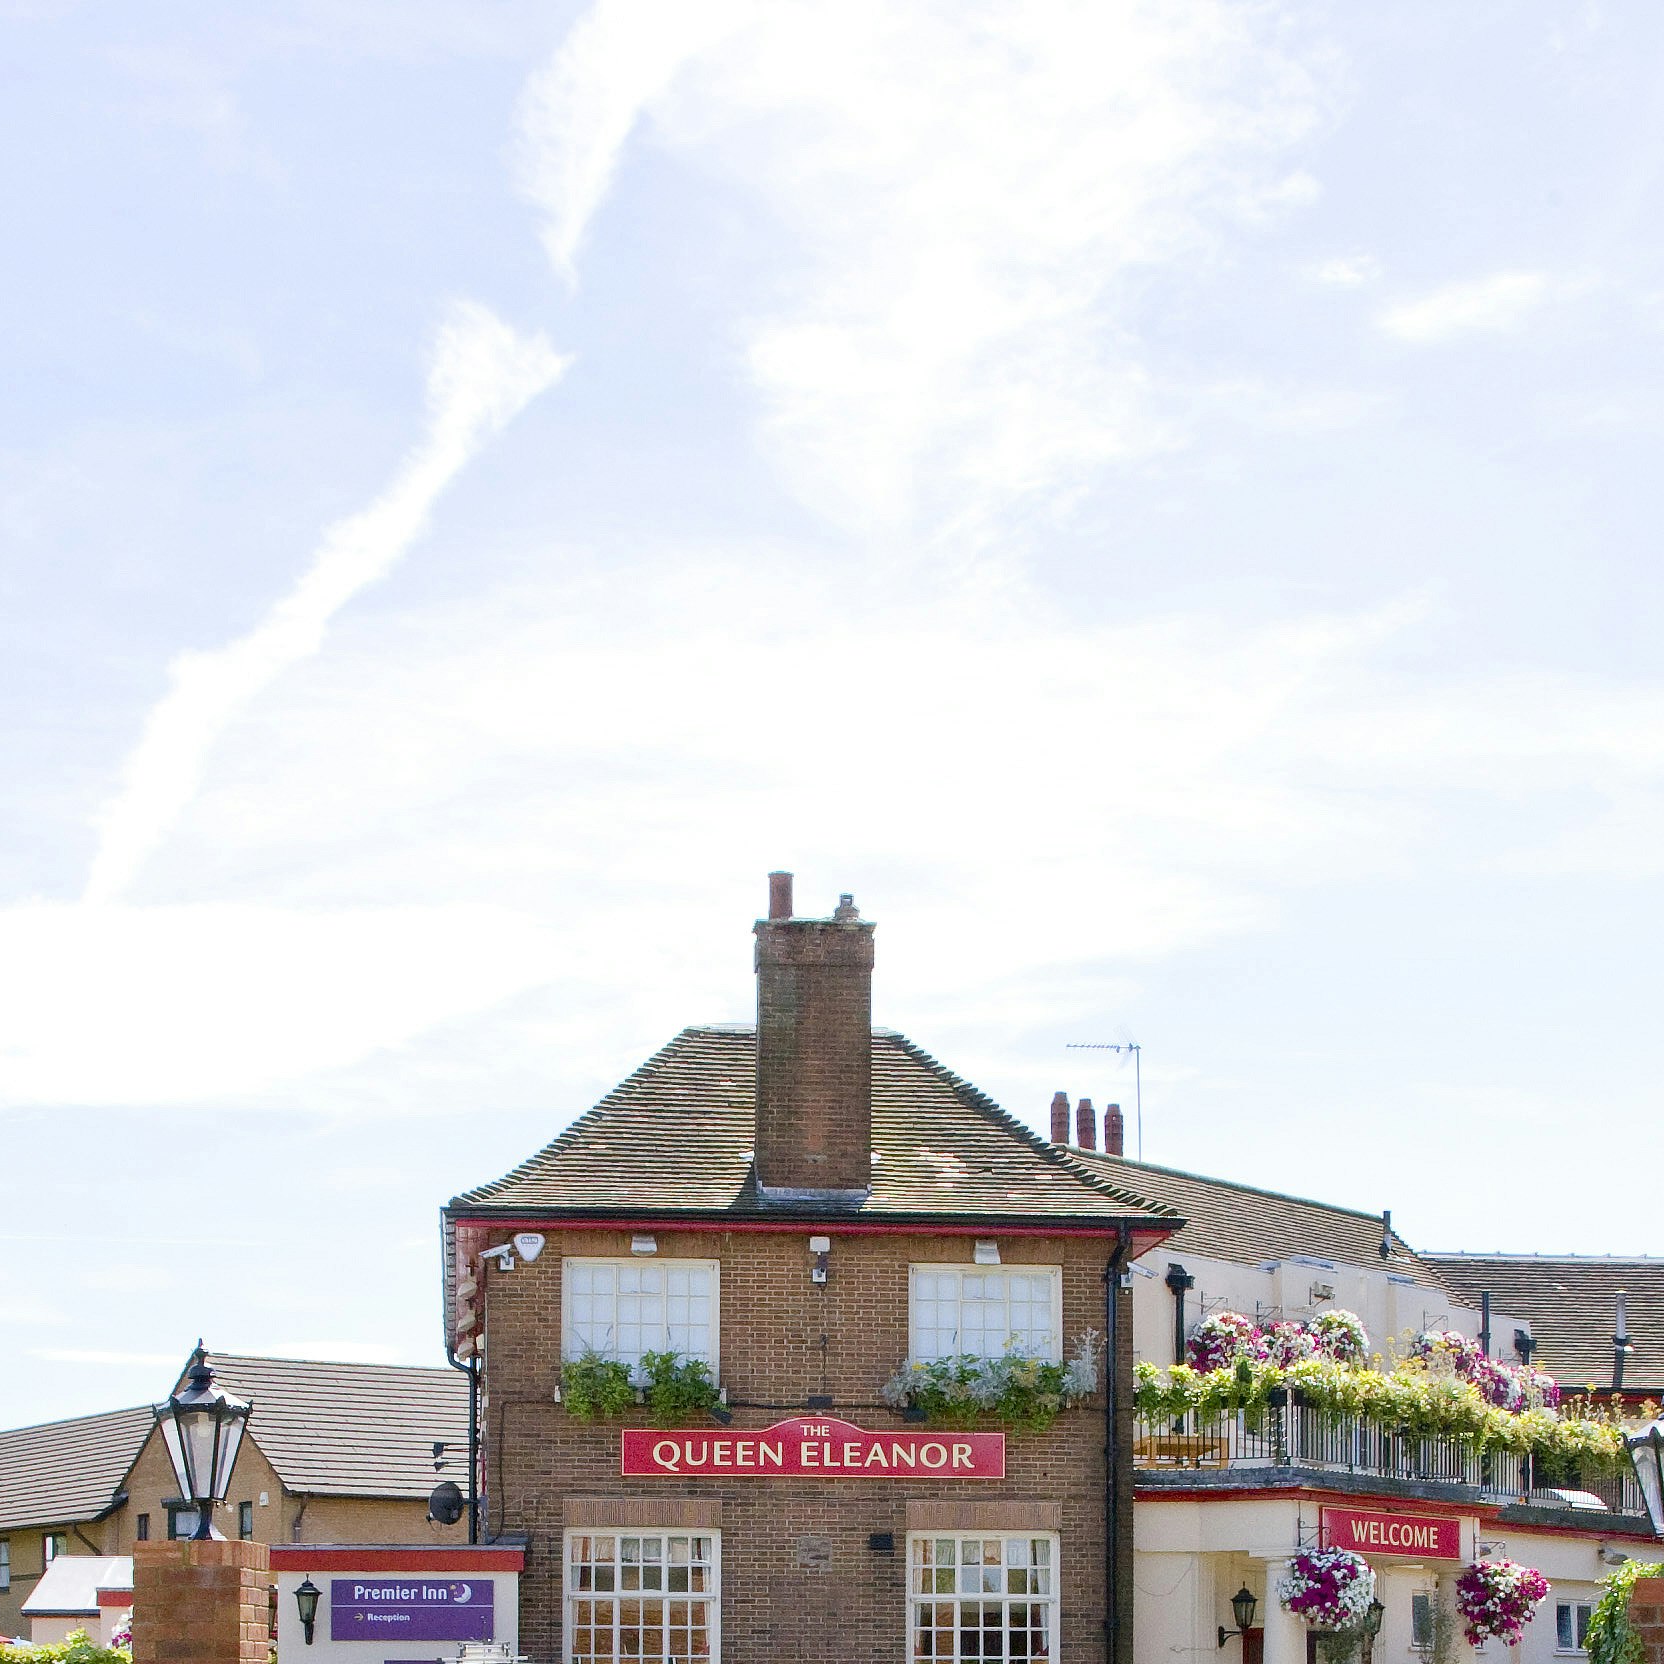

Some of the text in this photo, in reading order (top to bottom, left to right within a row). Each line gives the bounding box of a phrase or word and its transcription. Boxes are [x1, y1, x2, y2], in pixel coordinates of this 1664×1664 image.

[800, 1424, 830, 1437] THE
[652, 1440, 975, 1471] QUEEN ELEANOR
[1350, 1519, 1439, 1549] WELCOME
[354, 1585, 448, 1600] Premier Inn
[367, 1613, 411, 1623] Reception
